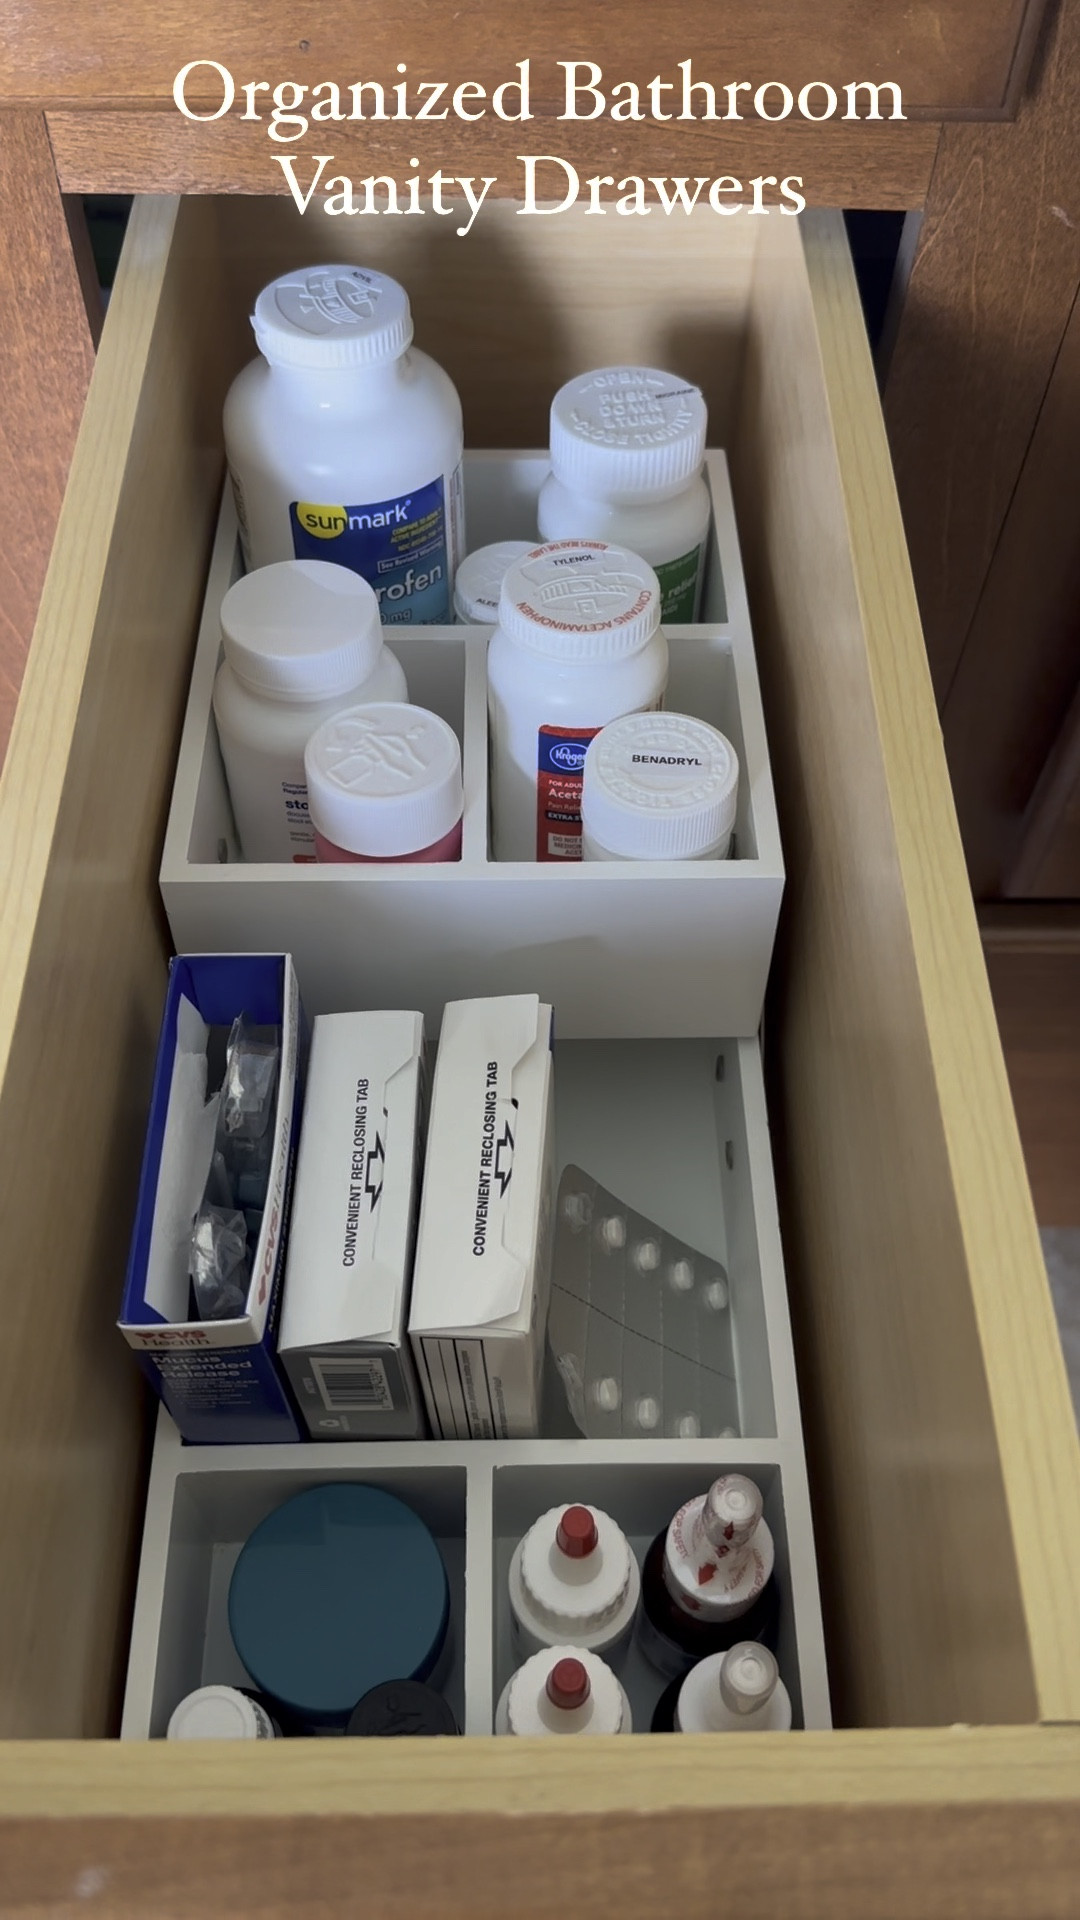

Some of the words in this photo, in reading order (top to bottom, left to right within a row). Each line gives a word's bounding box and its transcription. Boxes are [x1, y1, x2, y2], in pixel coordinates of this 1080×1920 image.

[593, 371, 645, 388] OPEN
[600, 401, 662, 418] DOWN
[553, 554, 596, 567] TYLENOL
[391, 608, 411, 622] mg
[613, 590, 653, 626] CONTAINS
[516, 601, 612, 634] ACETAMINOPHEN
[631, 754, 703, 766] BENADRYL
[548, 779, 563, 788] FOR
[547, 812, 573, 821] EXTRA
[486, 1061, 498, 1088] TAB
[356, 1078, 369, 1103] TAB
[480, 1090, 497, 1167] RECLOSING
[351, 1104, 368, 1181] RECLOSING
[472, 1170, 491, 1256] CONVENIENT
[343, 1183, 362, 1267] CONVENIENT
[140, 1338, 211, 1347] Health
[158, 1330, 206, 1339] CVS
[151, 1356, 222, 1365] Mucus
[157, 1361, 253, 1371] Extended
[161, 1370, 241, 1379] Release
[672, 1528, 689, 1559] SAFETY
